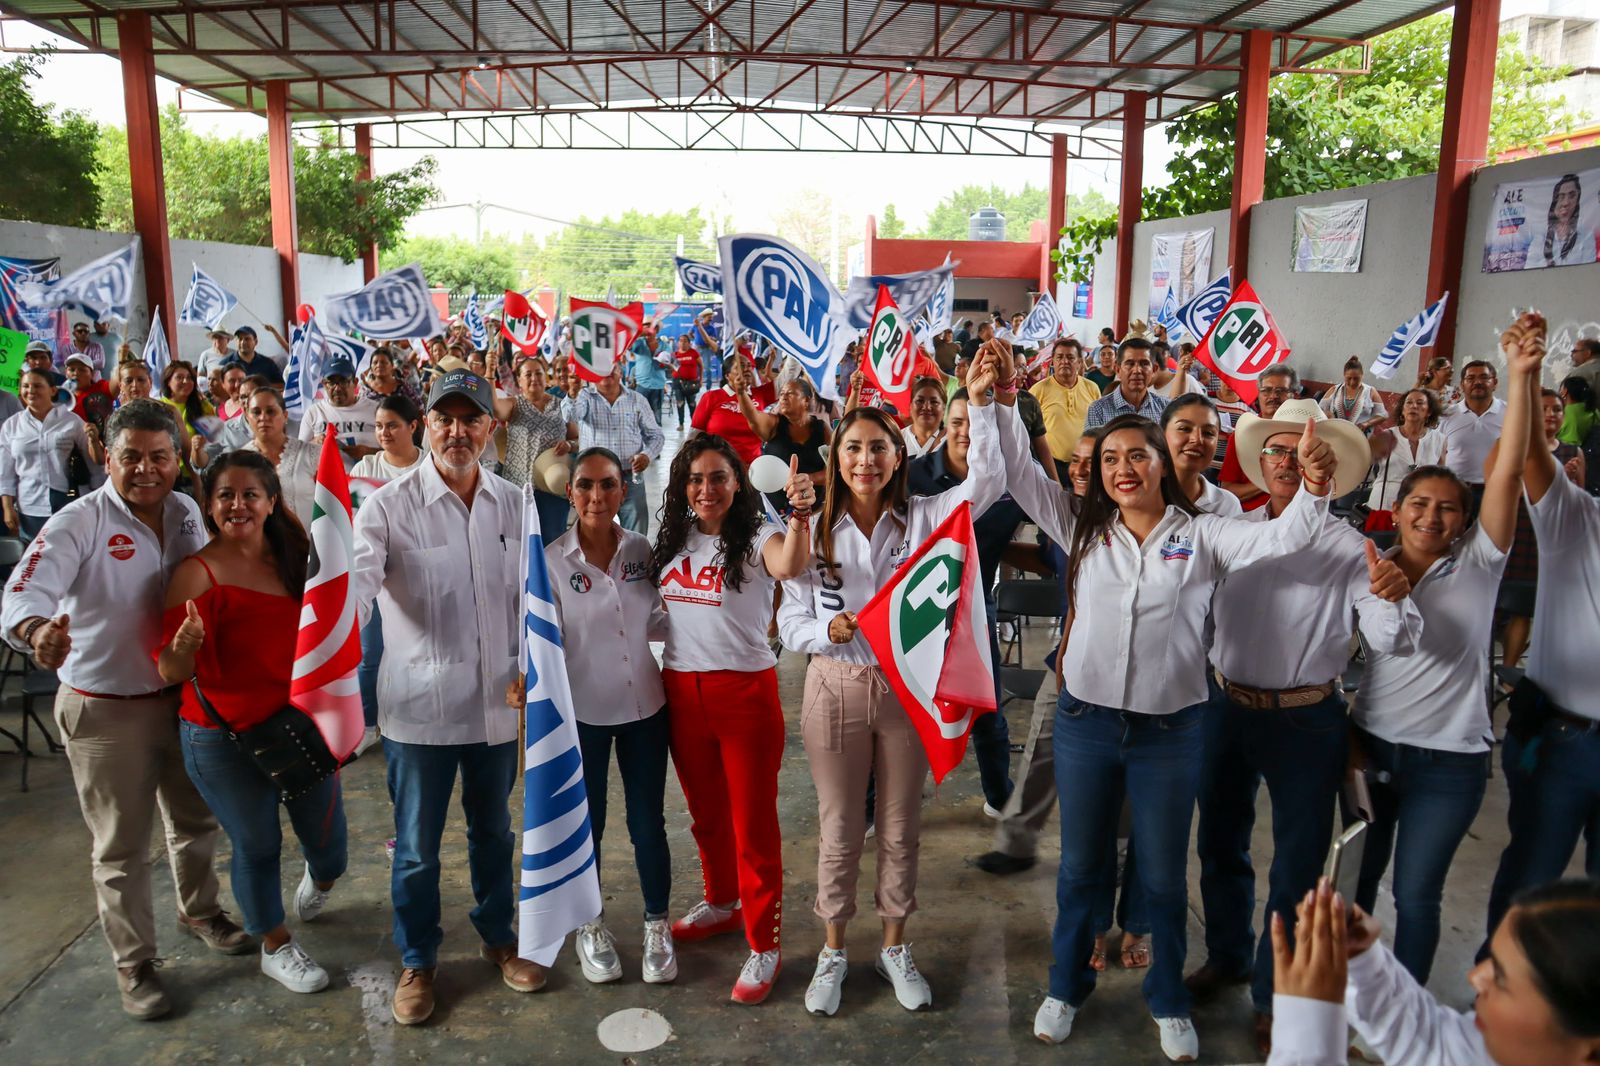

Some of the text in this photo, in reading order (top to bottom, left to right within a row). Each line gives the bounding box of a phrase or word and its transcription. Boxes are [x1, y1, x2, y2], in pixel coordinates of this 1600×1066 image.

[762, 265, 828, 347] PAN
[574, 322, 628, 353] PRI
[873, 319, 908, 376] PRI
[1217, 312, 1272, 367] PRI
[444, 374, 465, 383] LUCY
